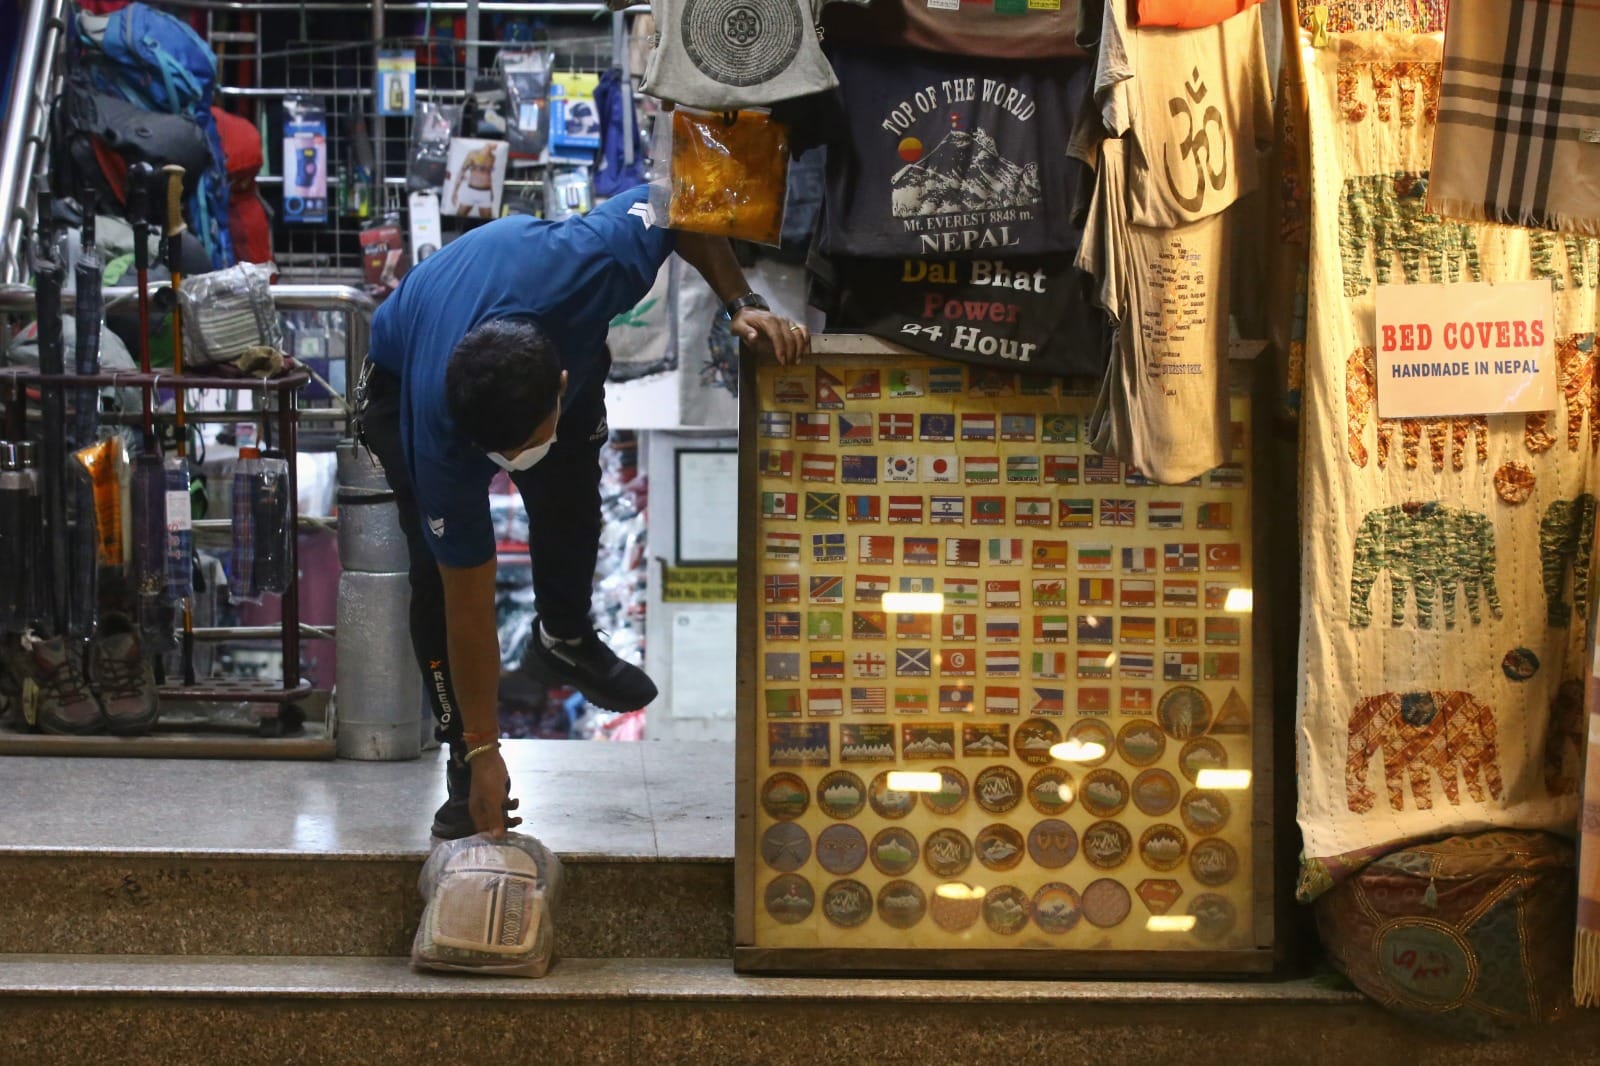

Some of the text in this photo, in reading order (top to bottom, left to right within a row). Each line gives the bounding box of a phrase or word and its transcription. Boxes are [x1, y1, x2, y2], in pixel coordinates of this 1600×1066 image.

[882, 78, 1036, 136] TOP OF THE WORLD
[903, 219, 924, 233] Mt.
[927, 213, 987, 231] EVEREST
[989, 209, 1016, 223] 8848
[920, 226, 1020, 255] NEPAL
[902, 259, 1047, 294] Dal Bhat
[922, 292, 1022, 323] Power
[900, 323, 1037, 362] 24 Hour
[1381, 319, 1545, 352] BED COVERS
[1392, 359, 1540, 378] HANDMADE IN NEPAL
